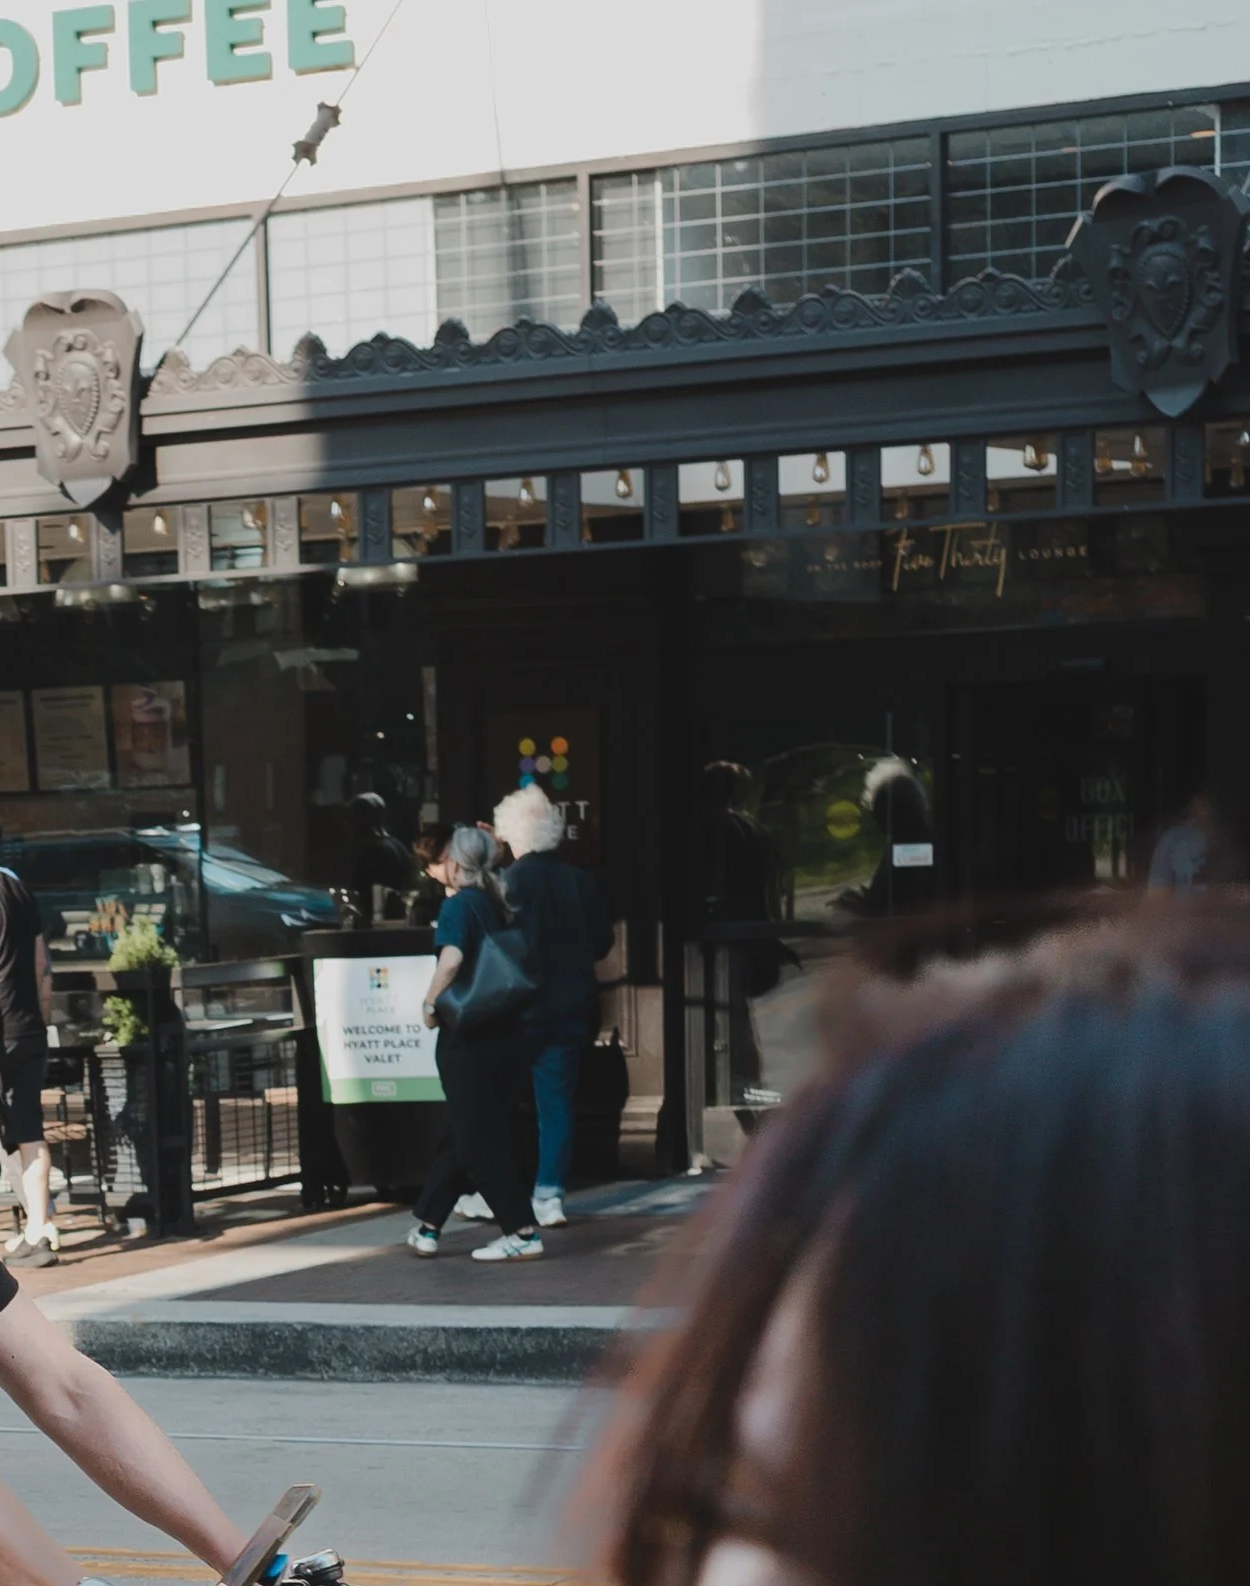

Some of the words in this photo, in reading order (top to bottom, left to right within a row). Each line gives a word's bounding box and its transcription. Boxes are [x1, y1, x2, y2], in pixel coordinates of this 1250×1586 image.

[928, 520, 1007, 600] Thirty
[343, 1024, 401, 1036] WELCOME
[405, 1024, 422, 1034] TO
[343, 1039, 380, 1050] HYATT
[383, 1038, 422, 1049] PLACE
[364, 1053, 402, 1064] VALET
